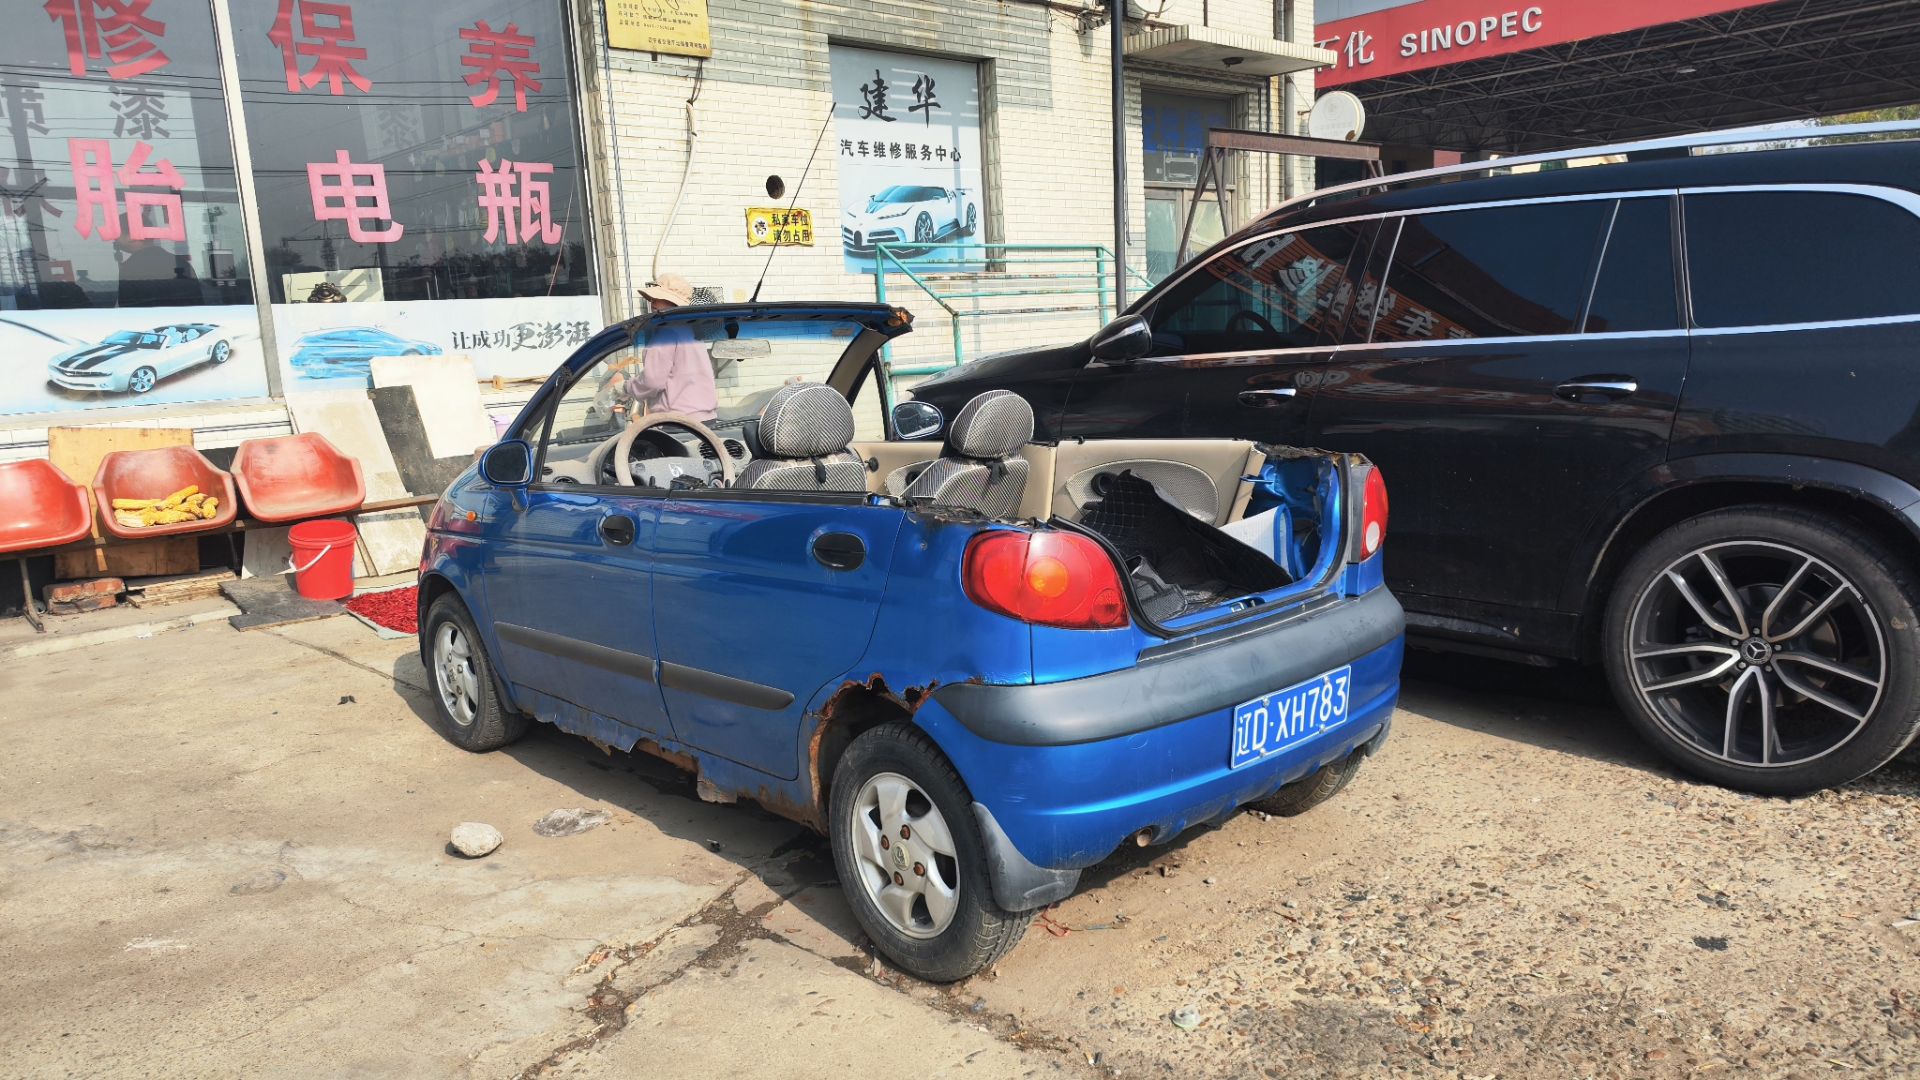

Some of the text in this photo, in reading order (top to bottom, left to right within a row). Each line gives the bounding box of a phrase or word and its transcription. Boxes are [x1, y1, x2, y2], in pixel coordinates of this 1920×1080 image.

[43, 0, 171, 80] 修
[267, 0, 543, 112] 保养
[1400, 6, 1542, 57] SINOPEC
[858, 69, 941, 128] 建华
[841, 139, 961, 162] 汽车维修服务中心
[68, 136, 187, 242] 胎
[306, 149, 563, 245] 电瓶
[772, 213, 809, 226] 私家车位
[773, 229, 810, 242] 请勿占用
[451, 320, 592, 351] 让成功更澎湃
